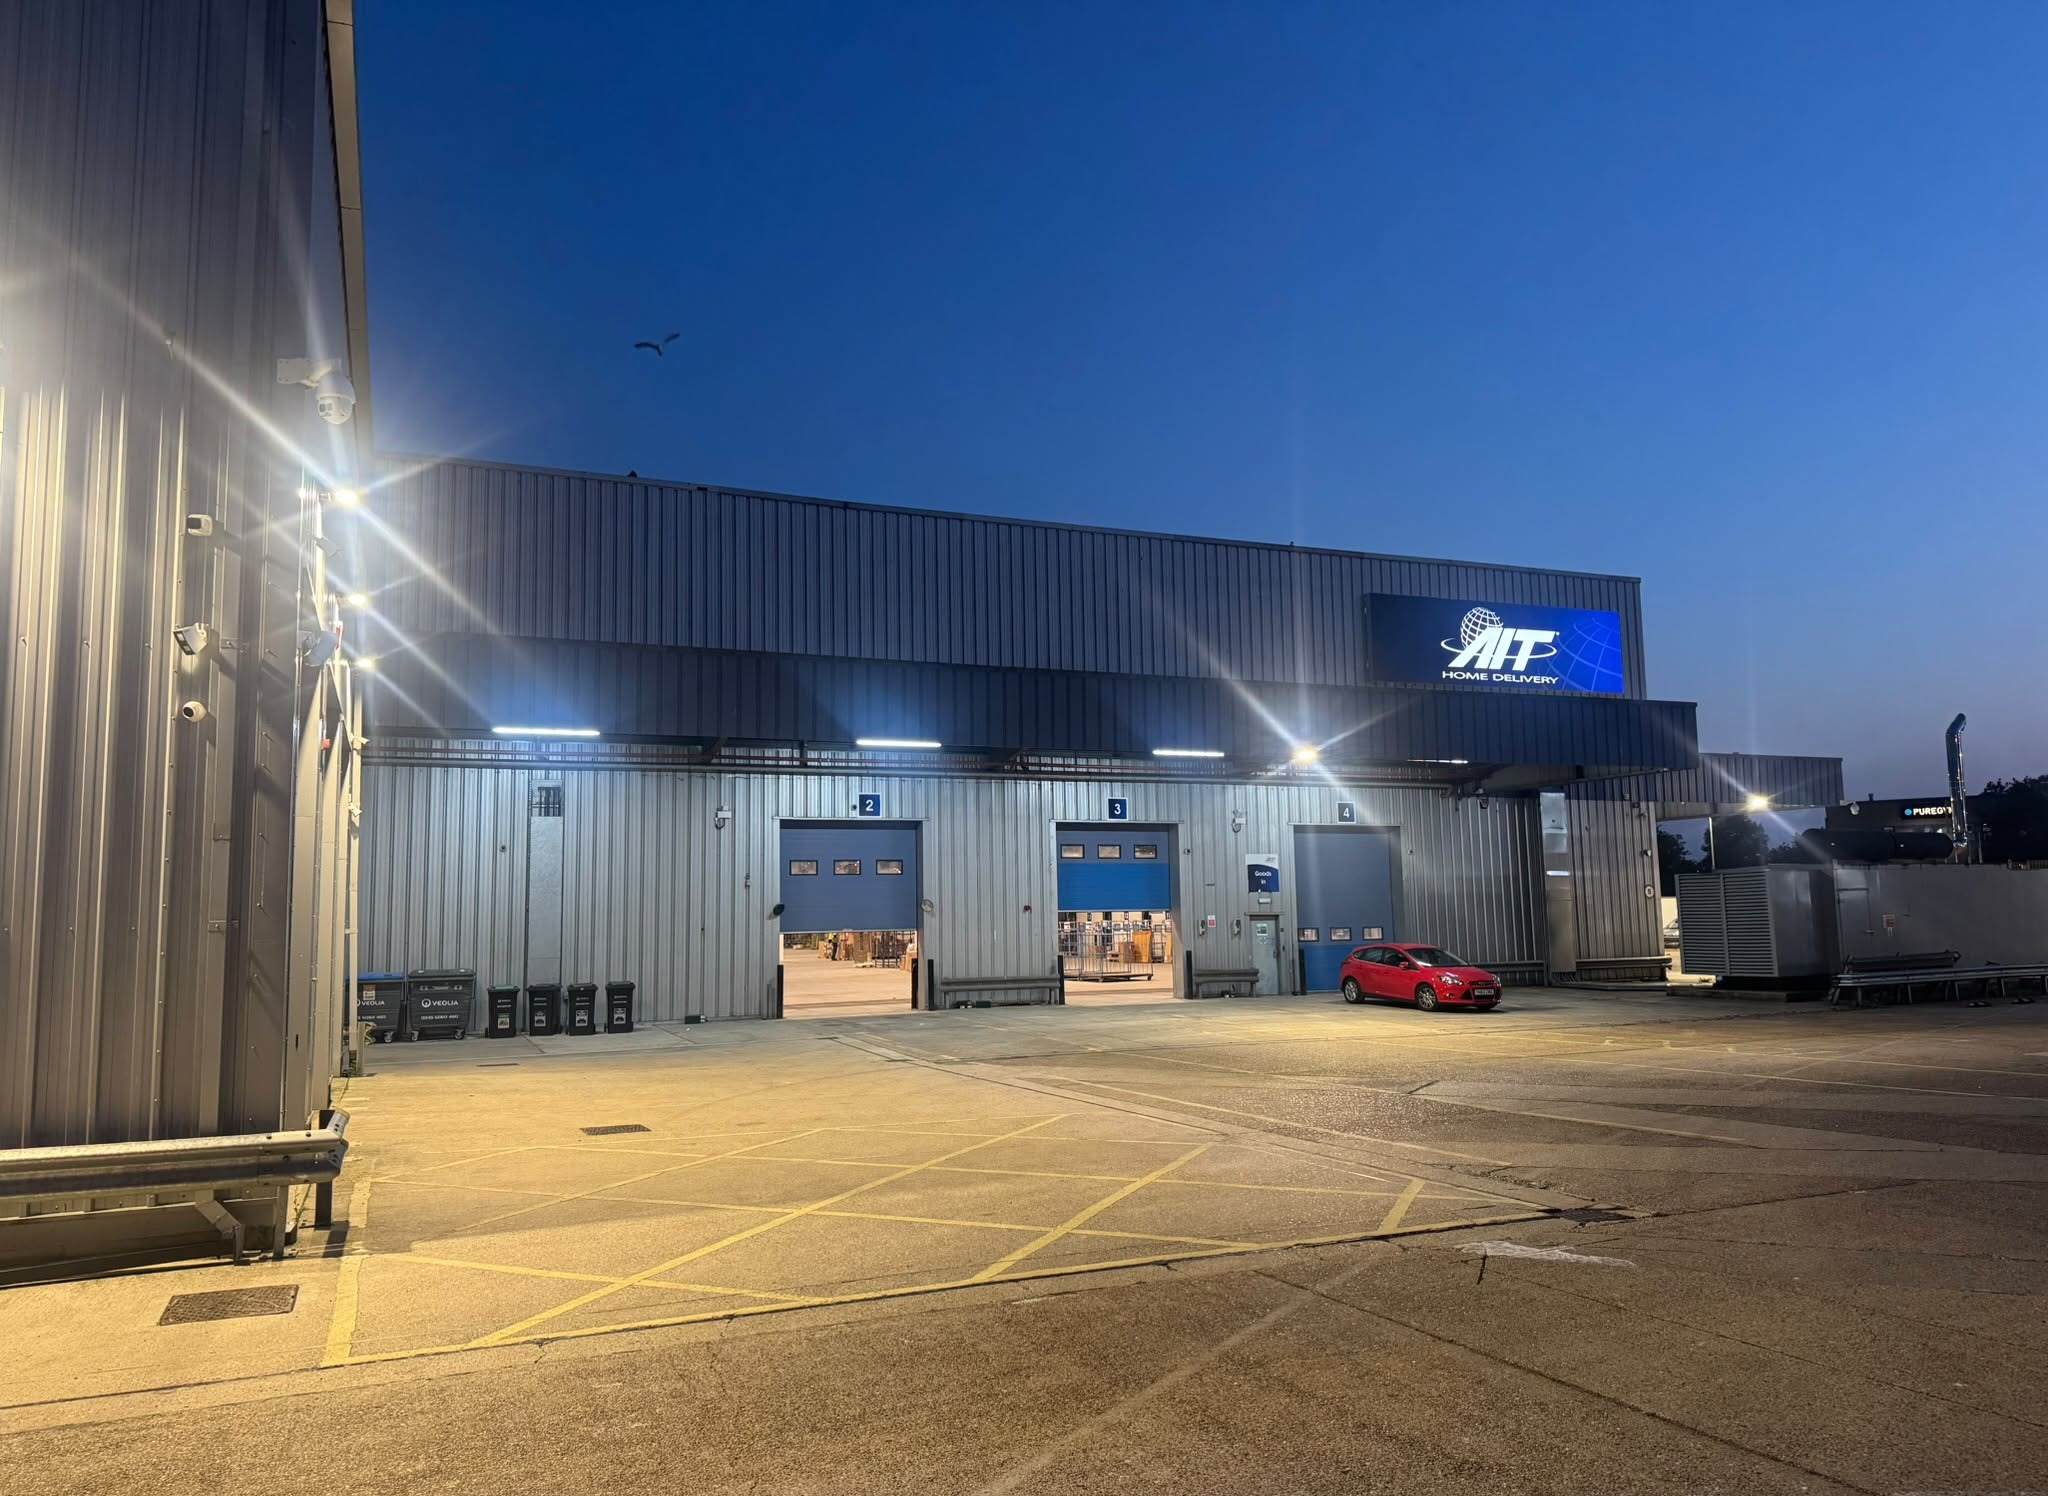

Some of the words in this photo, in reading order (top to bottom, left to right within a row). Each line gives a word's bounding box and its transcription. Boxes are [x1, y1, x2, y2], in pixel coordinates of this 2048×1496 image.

[1447, 626, 1556, 672] AIT
[1441, 670, 1489, 681] HOME
[1492, 673, 1559, 685] DELIVERY
[865, 799, 874, 812] 2
[1114, 803, 1122, 815] 3
[1342, 807, 1350, 819] 4
